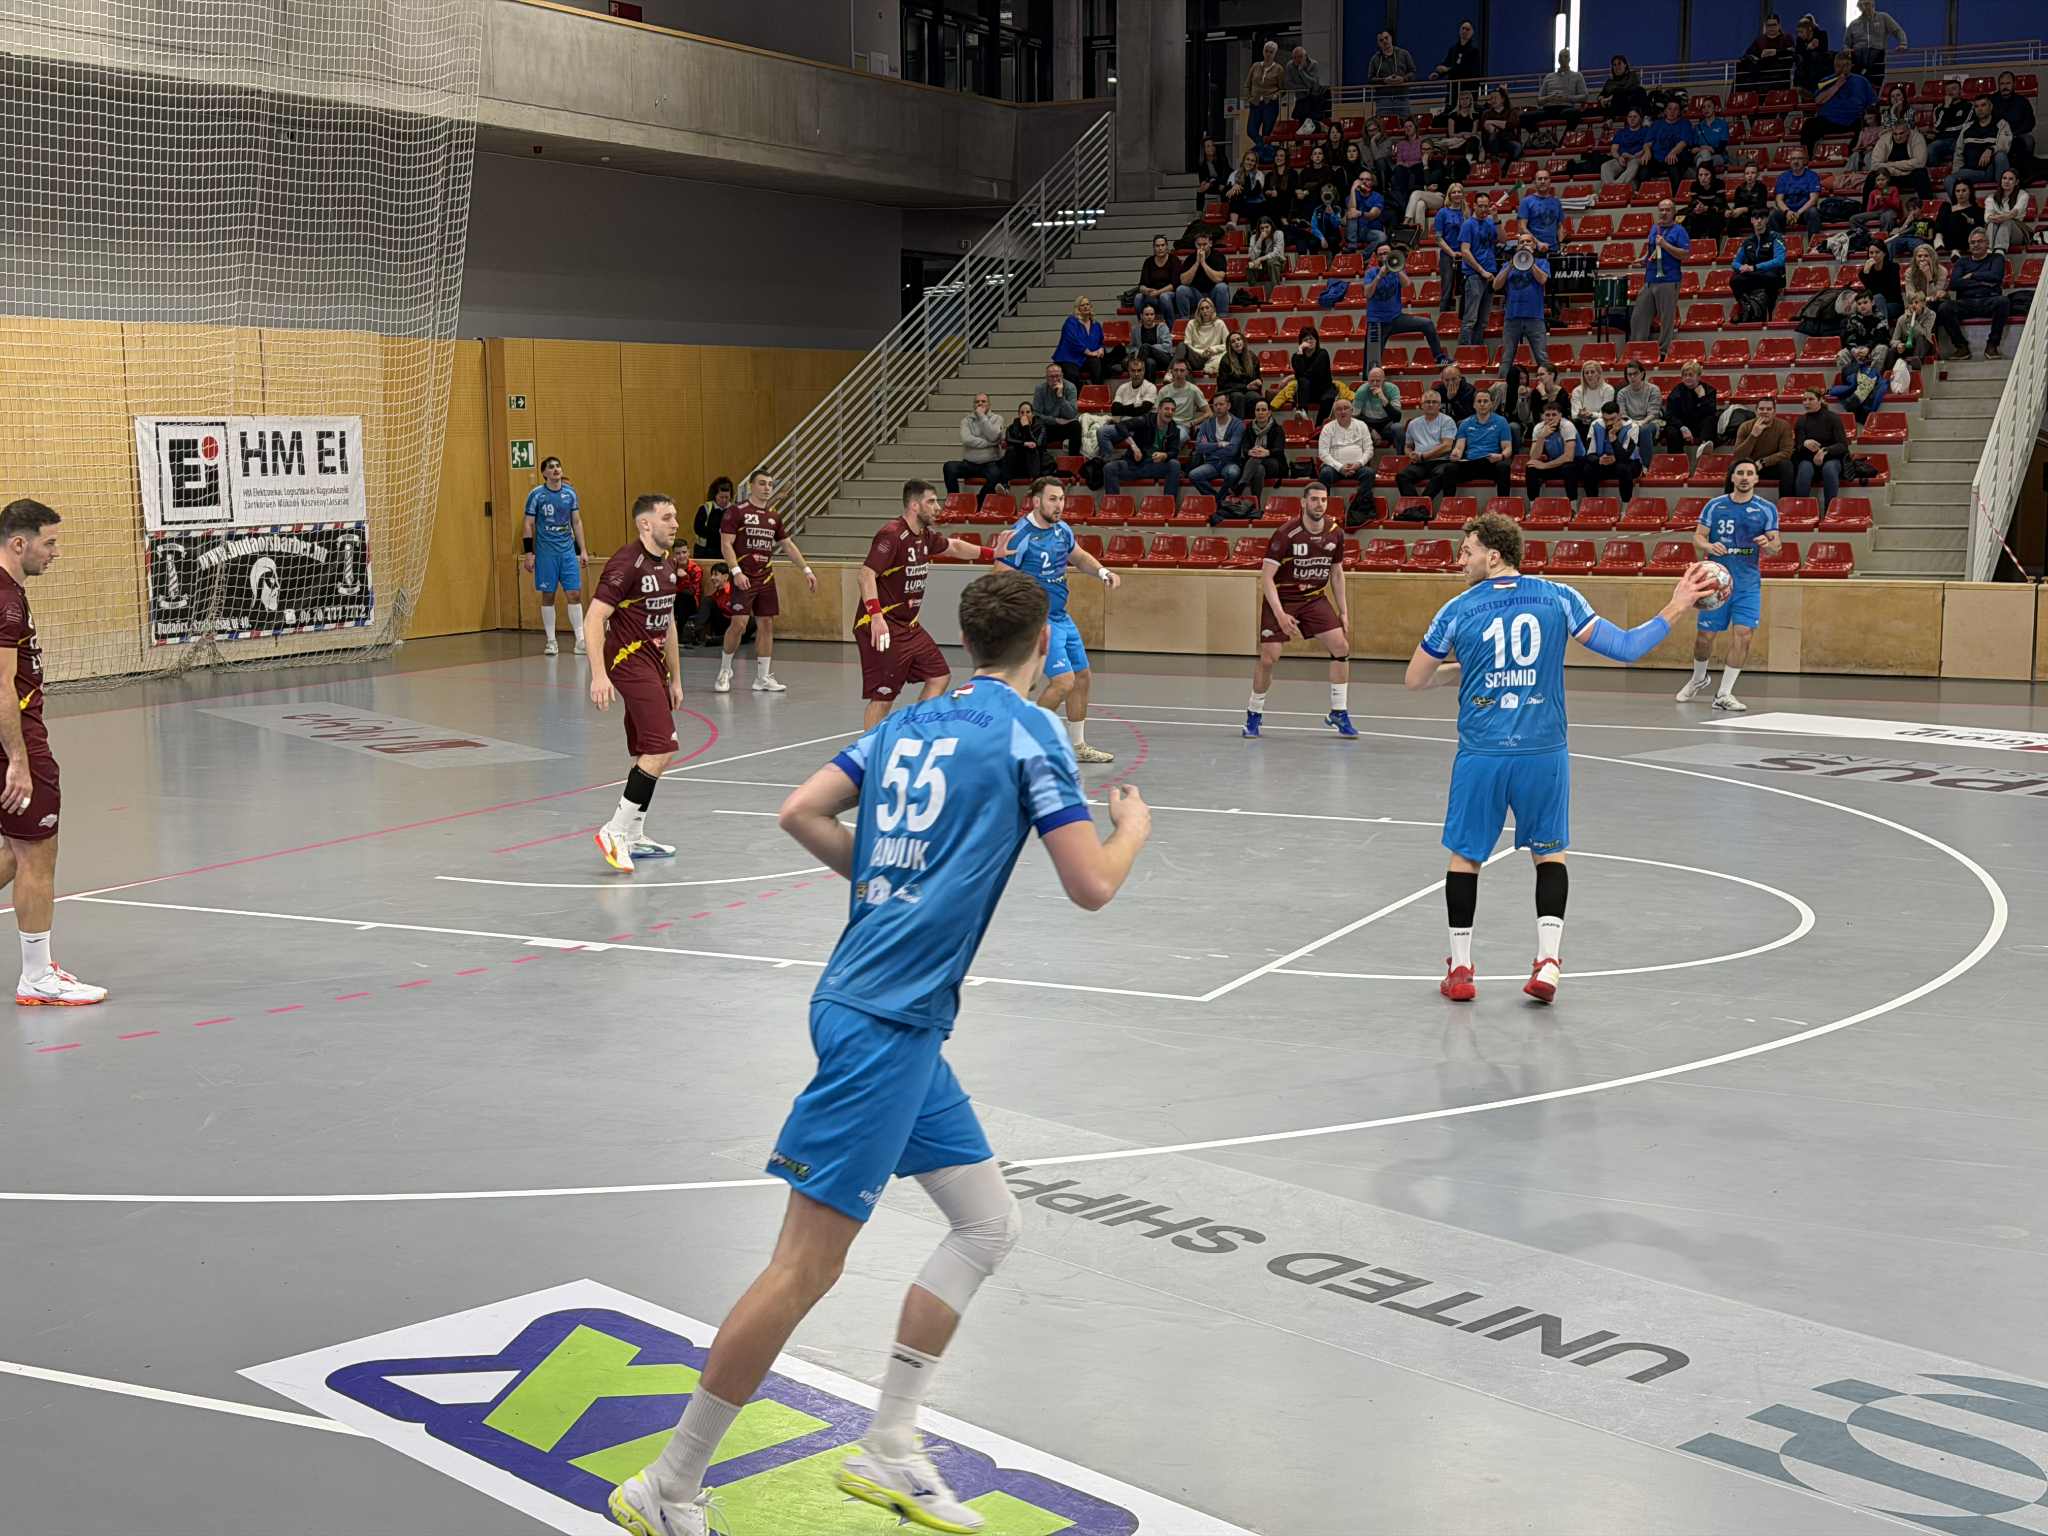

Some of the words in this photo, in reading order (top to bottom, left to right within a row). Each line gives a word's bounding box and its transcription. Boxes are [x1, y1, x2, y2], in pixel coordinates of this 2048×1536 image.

[1555, 270, 1585, 279] HAJRA
[240, 431, 305, 477] HM
[542, 504, 555, 516] 19
[744, 513, 760, 525] 23
[1717, 519, 1735, 535] 35
[907, 547, 916, 561] 3
[1293, 543, 1308, 556] 10
[1040, 551, 1051, 568] 2
[1293, 567, 1330, 578] LUPUS
[641, 575, 660, 593] 81
[1482, 613, 1541, 669] 10
[1485, 669, 1537, 689] SCHMID
[1895, 728, 2035, 746] Group
[876, 737, 960, 832] 55
[1266, 1252, 1690, 1384] UNITED
